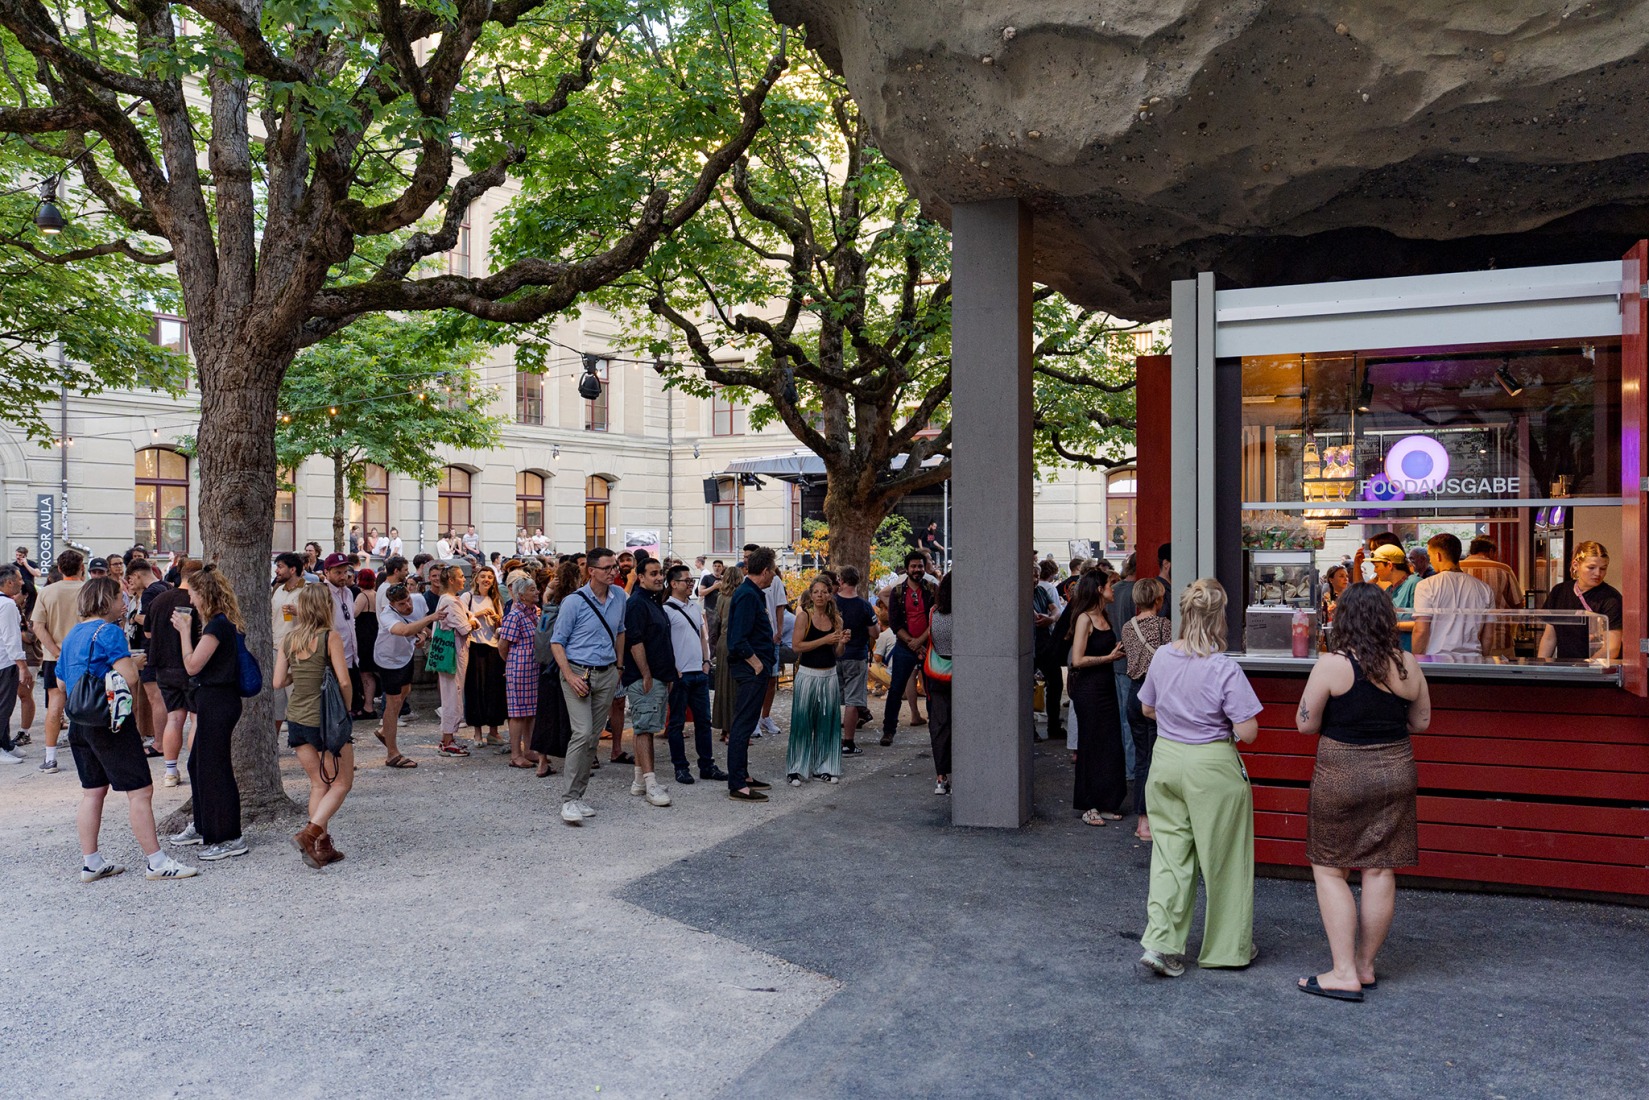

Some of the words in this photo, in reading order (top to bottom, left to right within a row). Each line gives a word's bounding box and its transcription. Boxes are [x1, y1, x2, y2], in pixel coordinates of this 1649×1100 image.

[1360, 477, 1520, 495] FOODAUSGABE
[41, 497, 51, 530] AULA
[41, 533, 51, 574] PROGR
